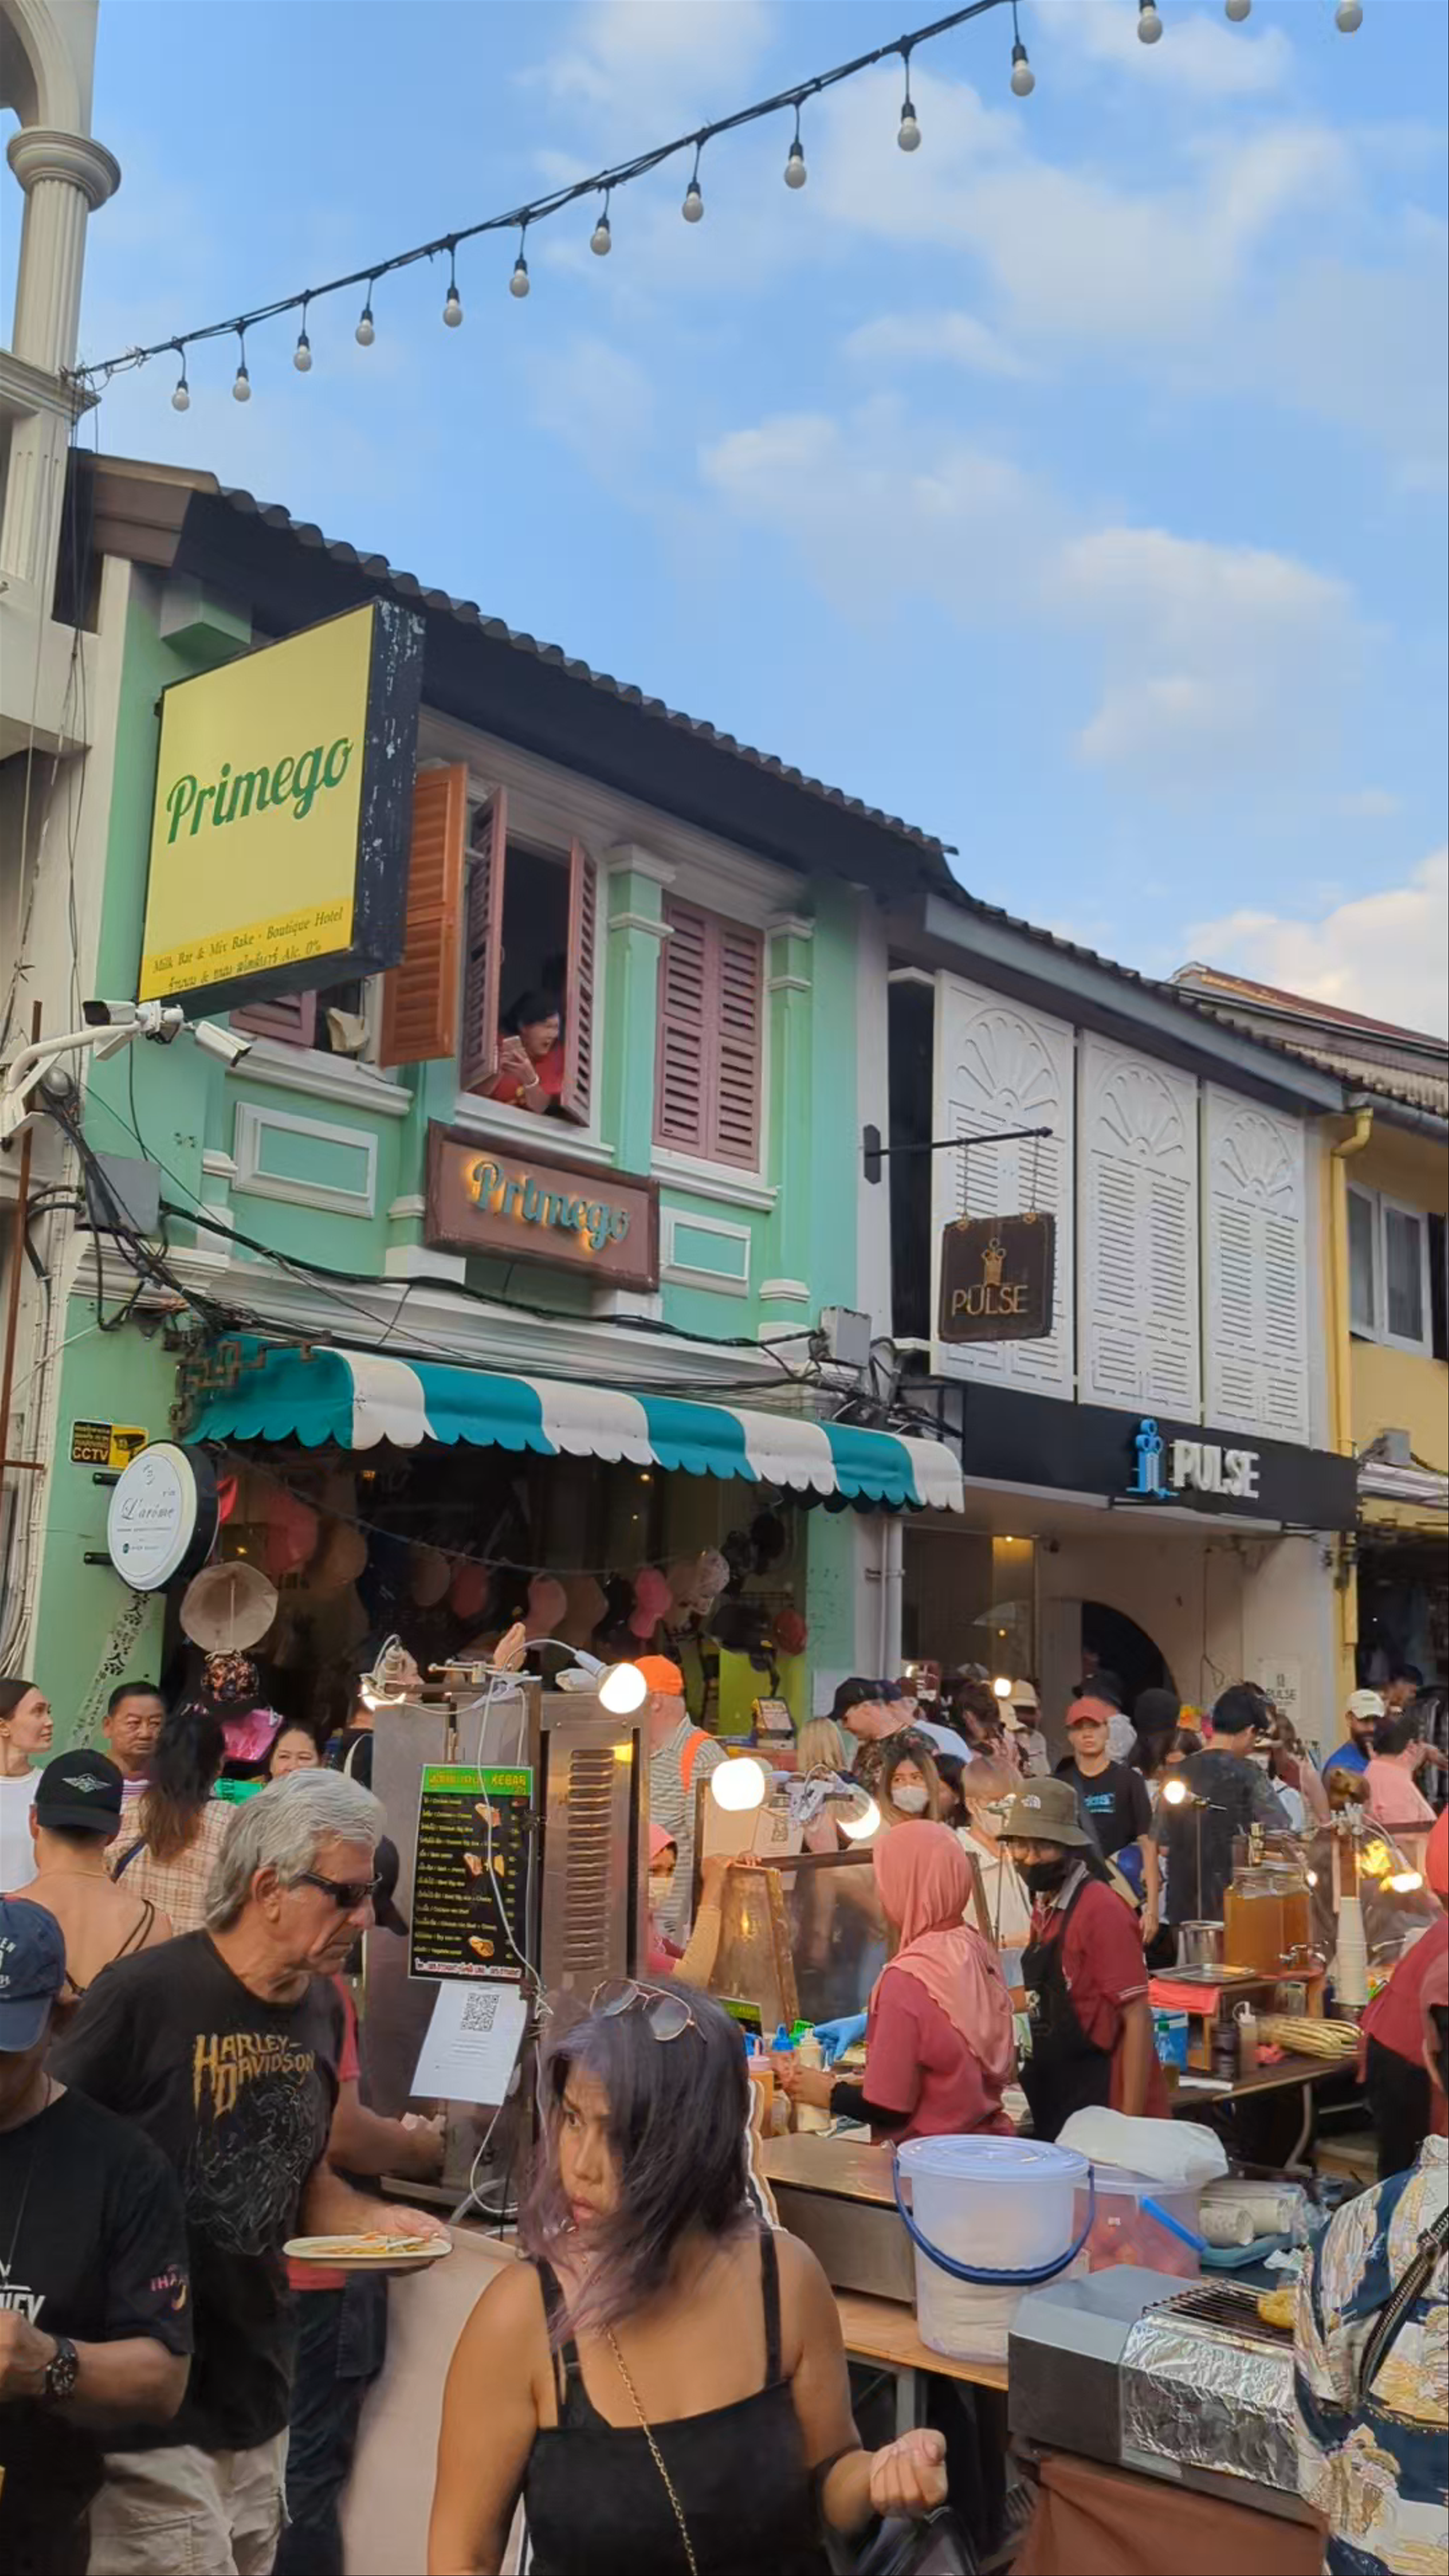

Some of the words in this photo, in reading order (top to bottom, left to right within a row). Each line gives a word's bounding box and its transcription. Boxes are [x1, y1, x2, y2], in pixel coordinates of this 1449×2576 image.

[166, 737, 354, 844] Primego
[152, 955, 173, 974] Milk
[178, 951, 193, 966] Bar
[197, 947, 205, 960] &
[231, 932, 255, 950] Bake
[266, 919, 311, 940] Boutique
[315, 906, 344, 927] Hotel
[472, 1160, 631, 1251] Primego
[951, 1283, 1028, 1317] PULSE
[73, 1447, 109, 1461] CCTV
[1173, 1439, 1260, 1498] PULSE
[193, 2032, 302, 2122] HARLEY-
[214, 2049, 316, 2121] DAVIDSON
